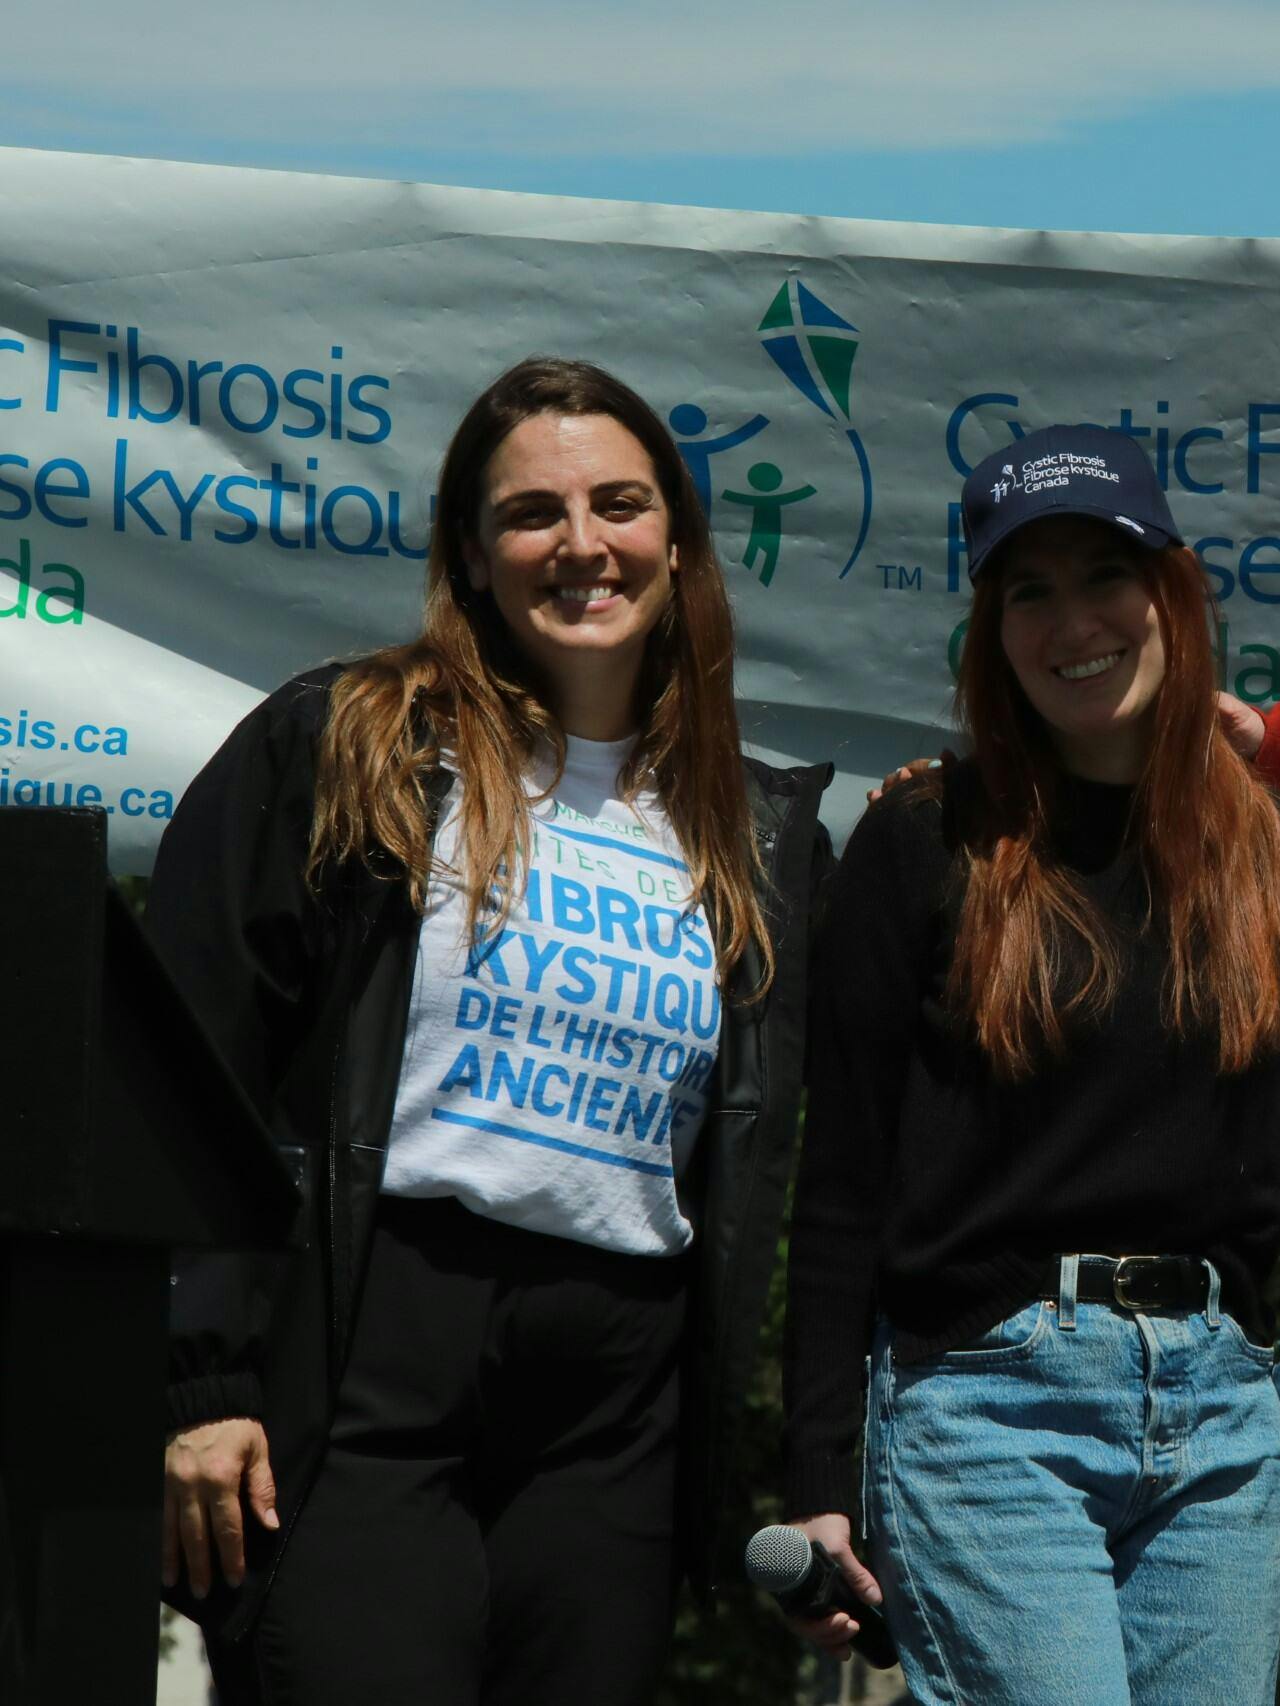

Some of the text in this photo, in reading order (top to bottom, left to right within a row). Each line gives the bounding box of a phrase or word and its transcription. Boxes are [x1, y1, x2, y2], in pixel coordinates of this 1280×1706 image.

[46, 318, 393, 445] Fibrosis
[1022, 452, 1106, 473] Cystic Fibrosis
[1023, 465, 1070, 485] Fibrose
[113, 438, 439, 560] kystiqu
[1024, 475, 1070, 494] Canada
[876, 564, 922, 592] TM
[636, 870, 678, 903] DE
[464, 924, 721, 1040] KYSTIQU
[455, 988, 521, 1039] DE
